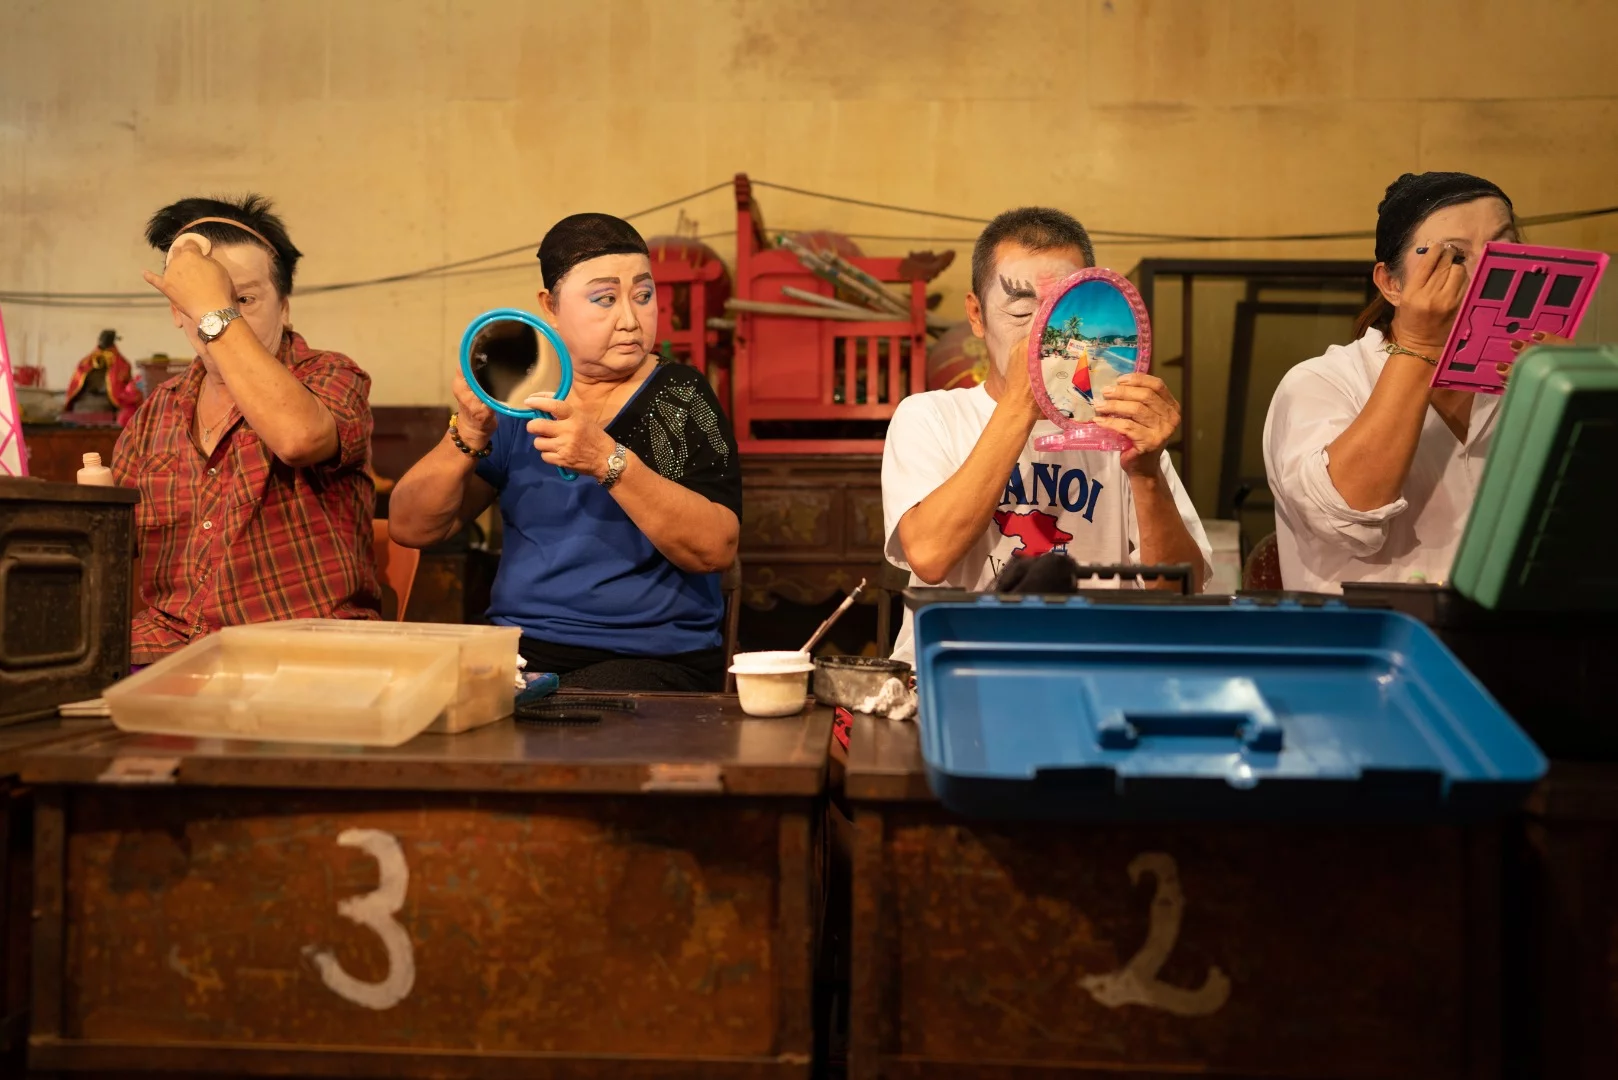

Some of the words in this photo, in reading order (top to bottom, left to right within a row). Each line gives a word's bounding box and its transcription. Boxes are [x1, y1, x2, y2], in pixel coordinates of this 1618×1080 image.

[999, 462, 1104, 524] ANOI
[301, 828, 416, 1011] 3
[1076, 852, 1232, 1017] 2
